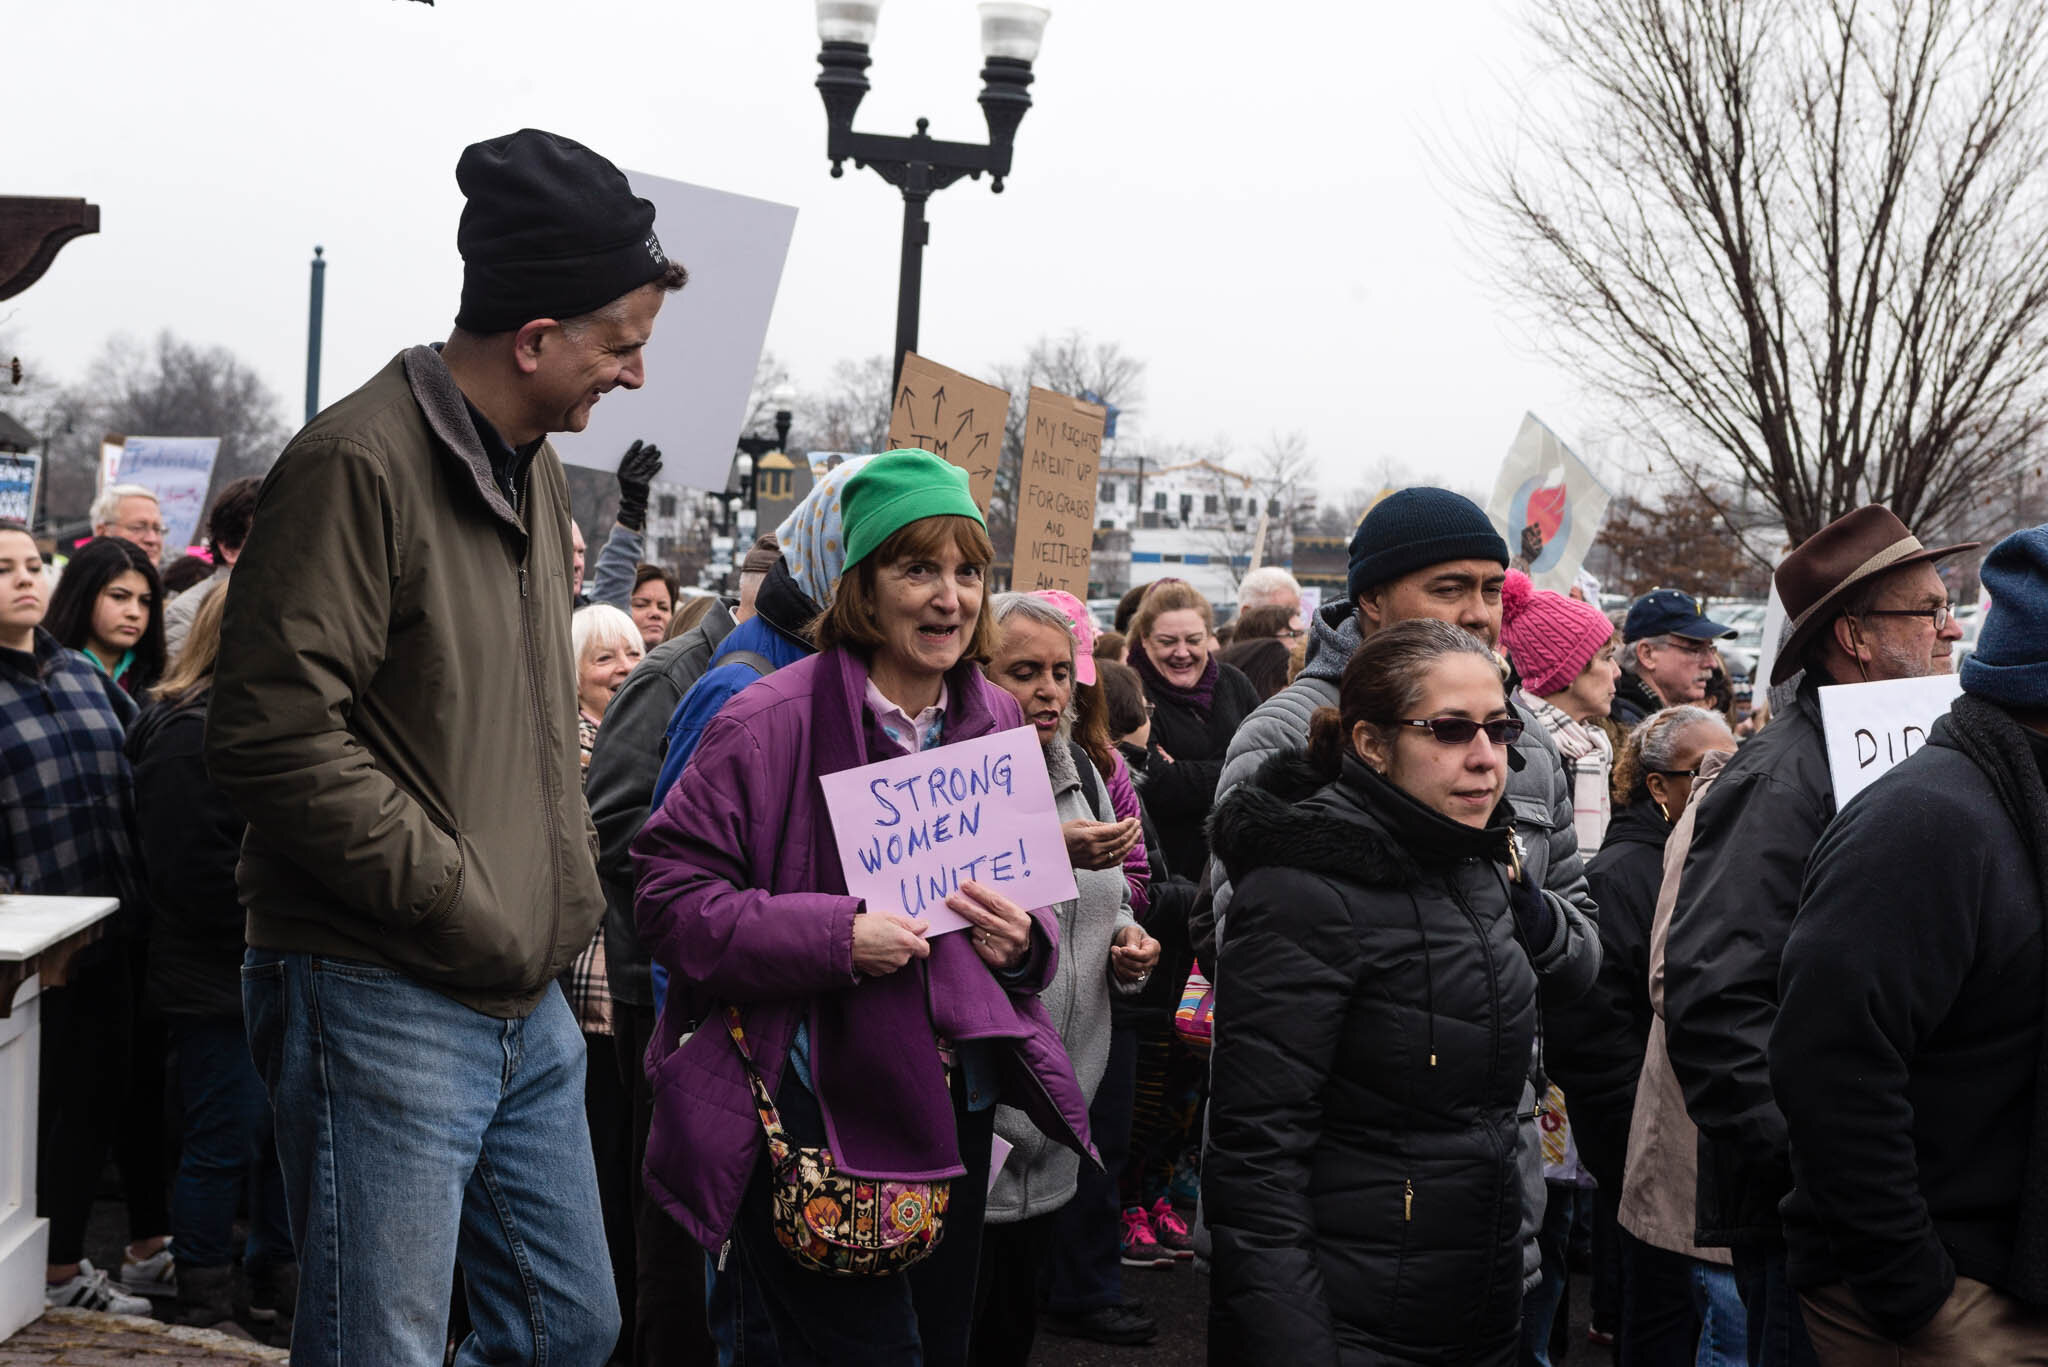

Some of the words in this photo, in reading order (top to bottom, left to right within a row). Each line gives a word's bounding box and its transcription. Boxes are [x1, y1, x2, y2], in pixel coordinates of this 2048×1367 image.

[1062, 422, 1098, 455] RIGHTS
[1077, 463, 1092, 481] UP
[1028, 484, 1053, 511] FOR
[1055, 492, 1089, 520] GRABS
[1044, 519, 1065, 538] AND
[1031, 541, 1089, 568] NEITHER
[869, 753, 1015, 827] STRONG
[858, 801, 980, 875] WOMEN
[900, 837, 1032, 918] UNITE!
